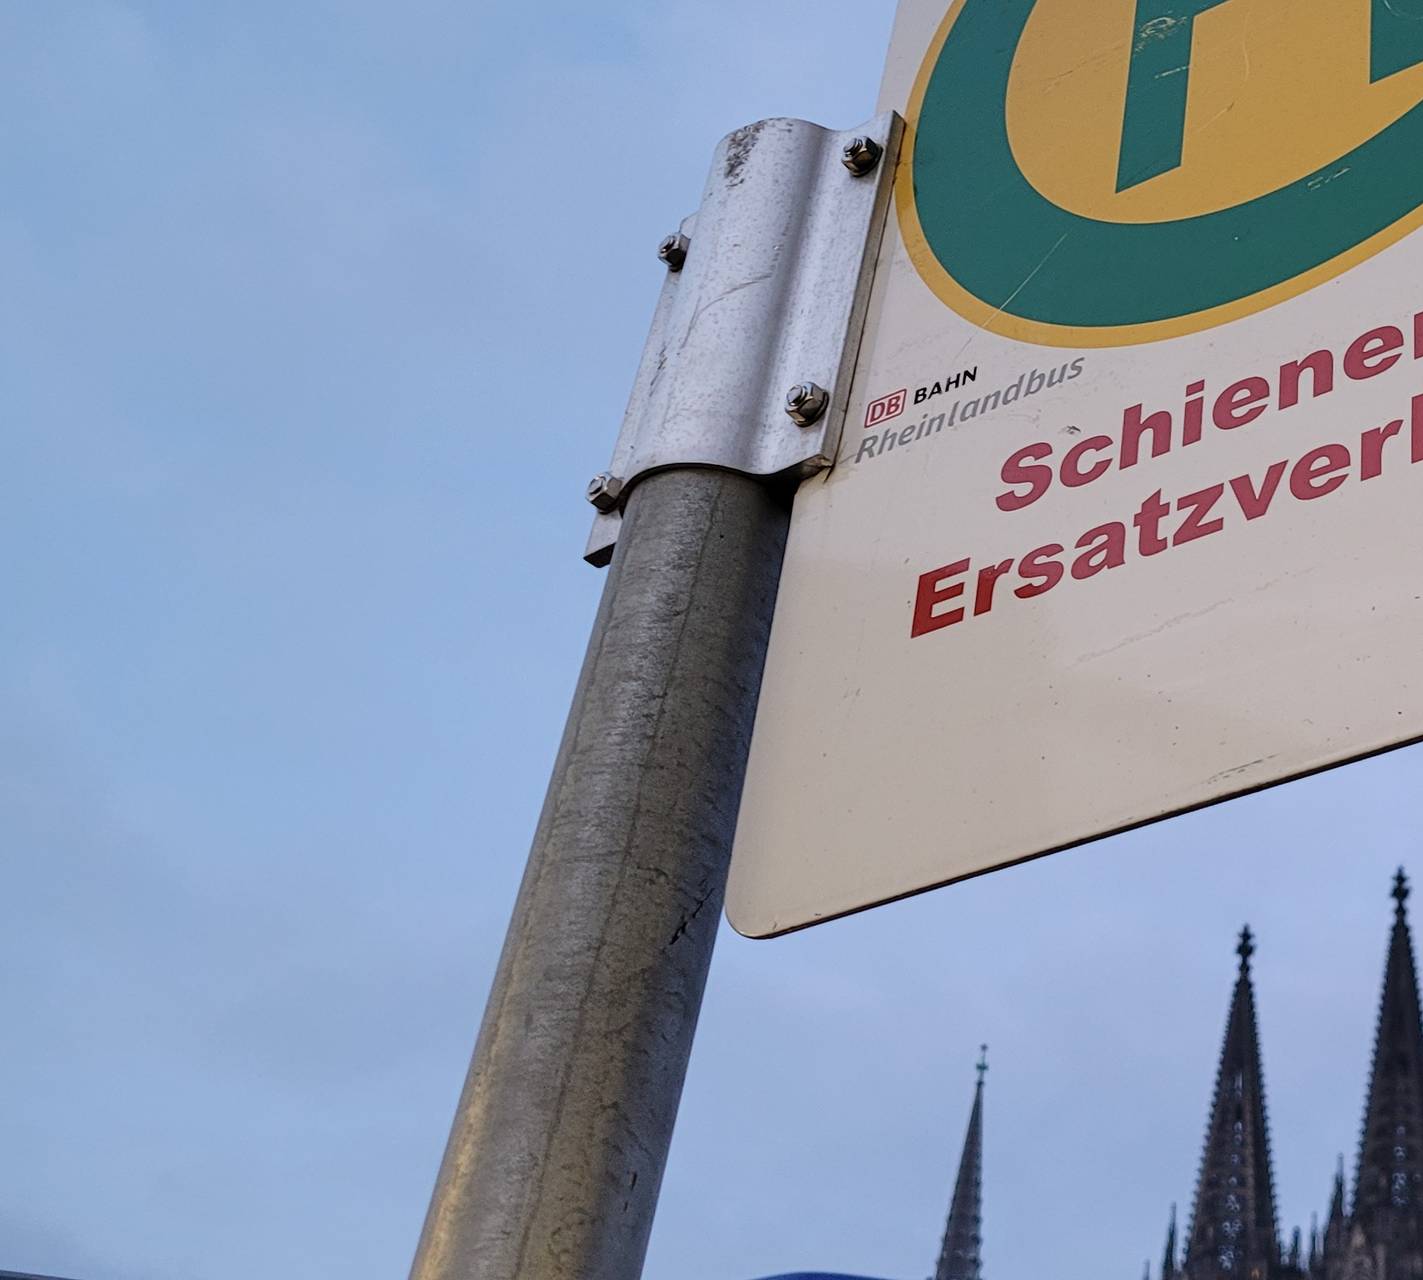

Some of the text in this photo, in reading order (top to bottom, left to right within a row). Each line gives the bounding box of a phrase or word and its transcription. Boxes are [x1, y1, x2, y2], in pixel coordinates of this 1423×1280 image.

[854, 356, 1085, 464] Rheinlandbus
[868, 365, 978, 425] DB BAHN
